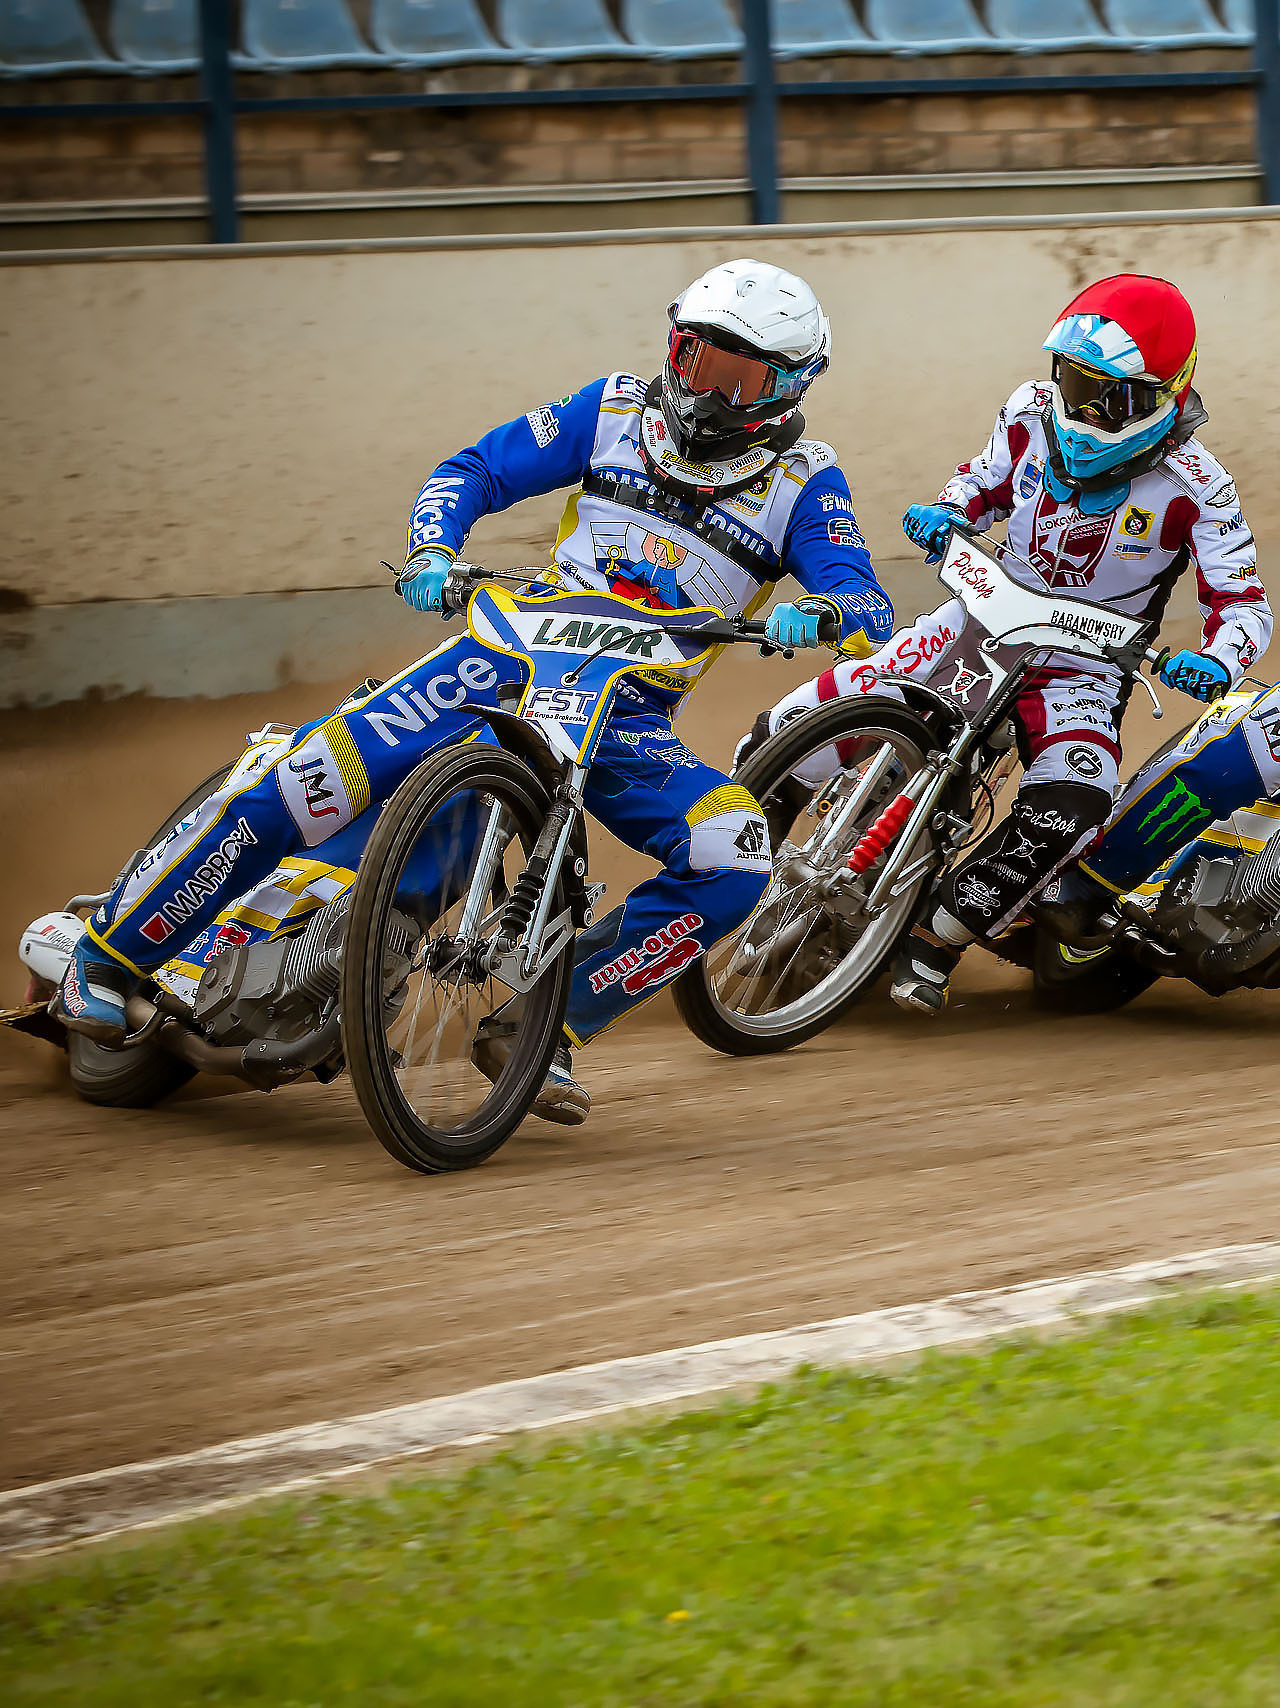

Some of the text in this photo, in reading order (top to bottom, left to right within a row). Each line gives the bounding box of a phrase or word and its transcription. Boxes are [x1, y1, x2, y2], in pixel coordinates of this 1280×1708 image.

[532, 618, 663, 658] LAVOR
[362, 656, 499, 747] Nice
[528, 688, 597, 714] FST
[534, 711, 587, 724] Grupa Brokerska
